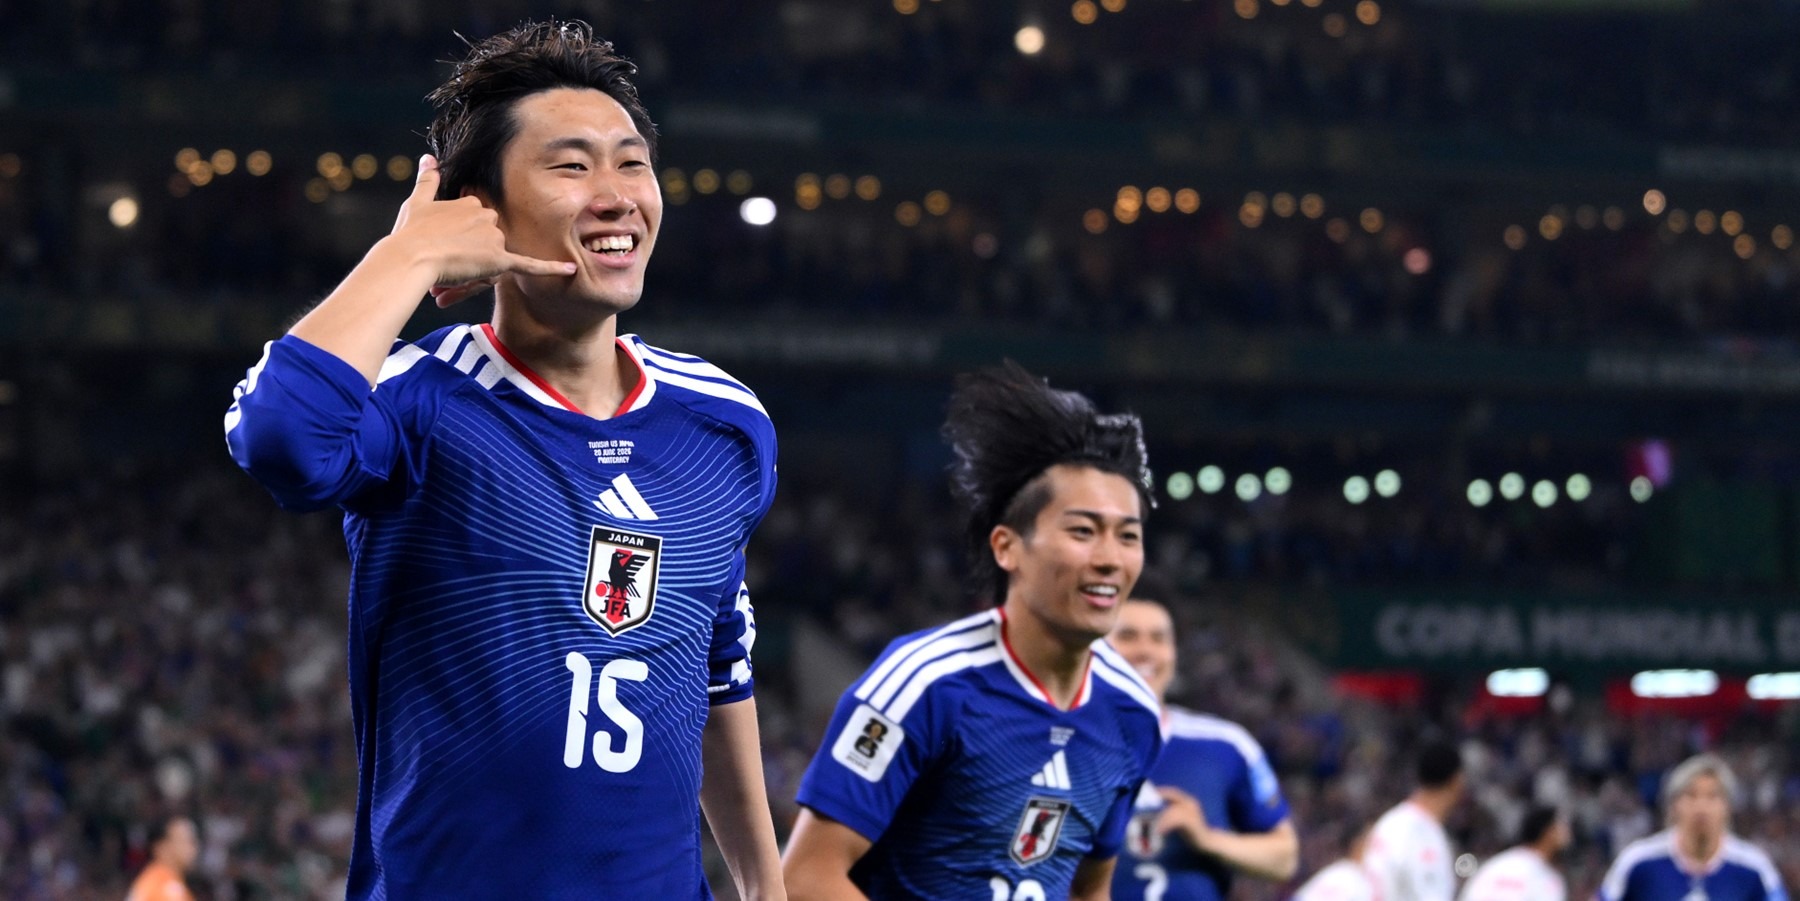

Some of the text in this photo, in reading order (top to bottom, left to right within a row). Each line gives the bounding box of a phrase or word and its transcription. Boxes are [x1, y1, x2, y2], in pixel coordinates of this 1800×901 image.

[603, 448, 615, 456] JUNE
[608, 532, 645, 547] JAPAN
[599, 599, 631, 619] JFA
[1375, 602, 1523, 657] COPA
[1531, 604, 1768, 661] MUNDIAL
[563, 651, 649, 774] 15
